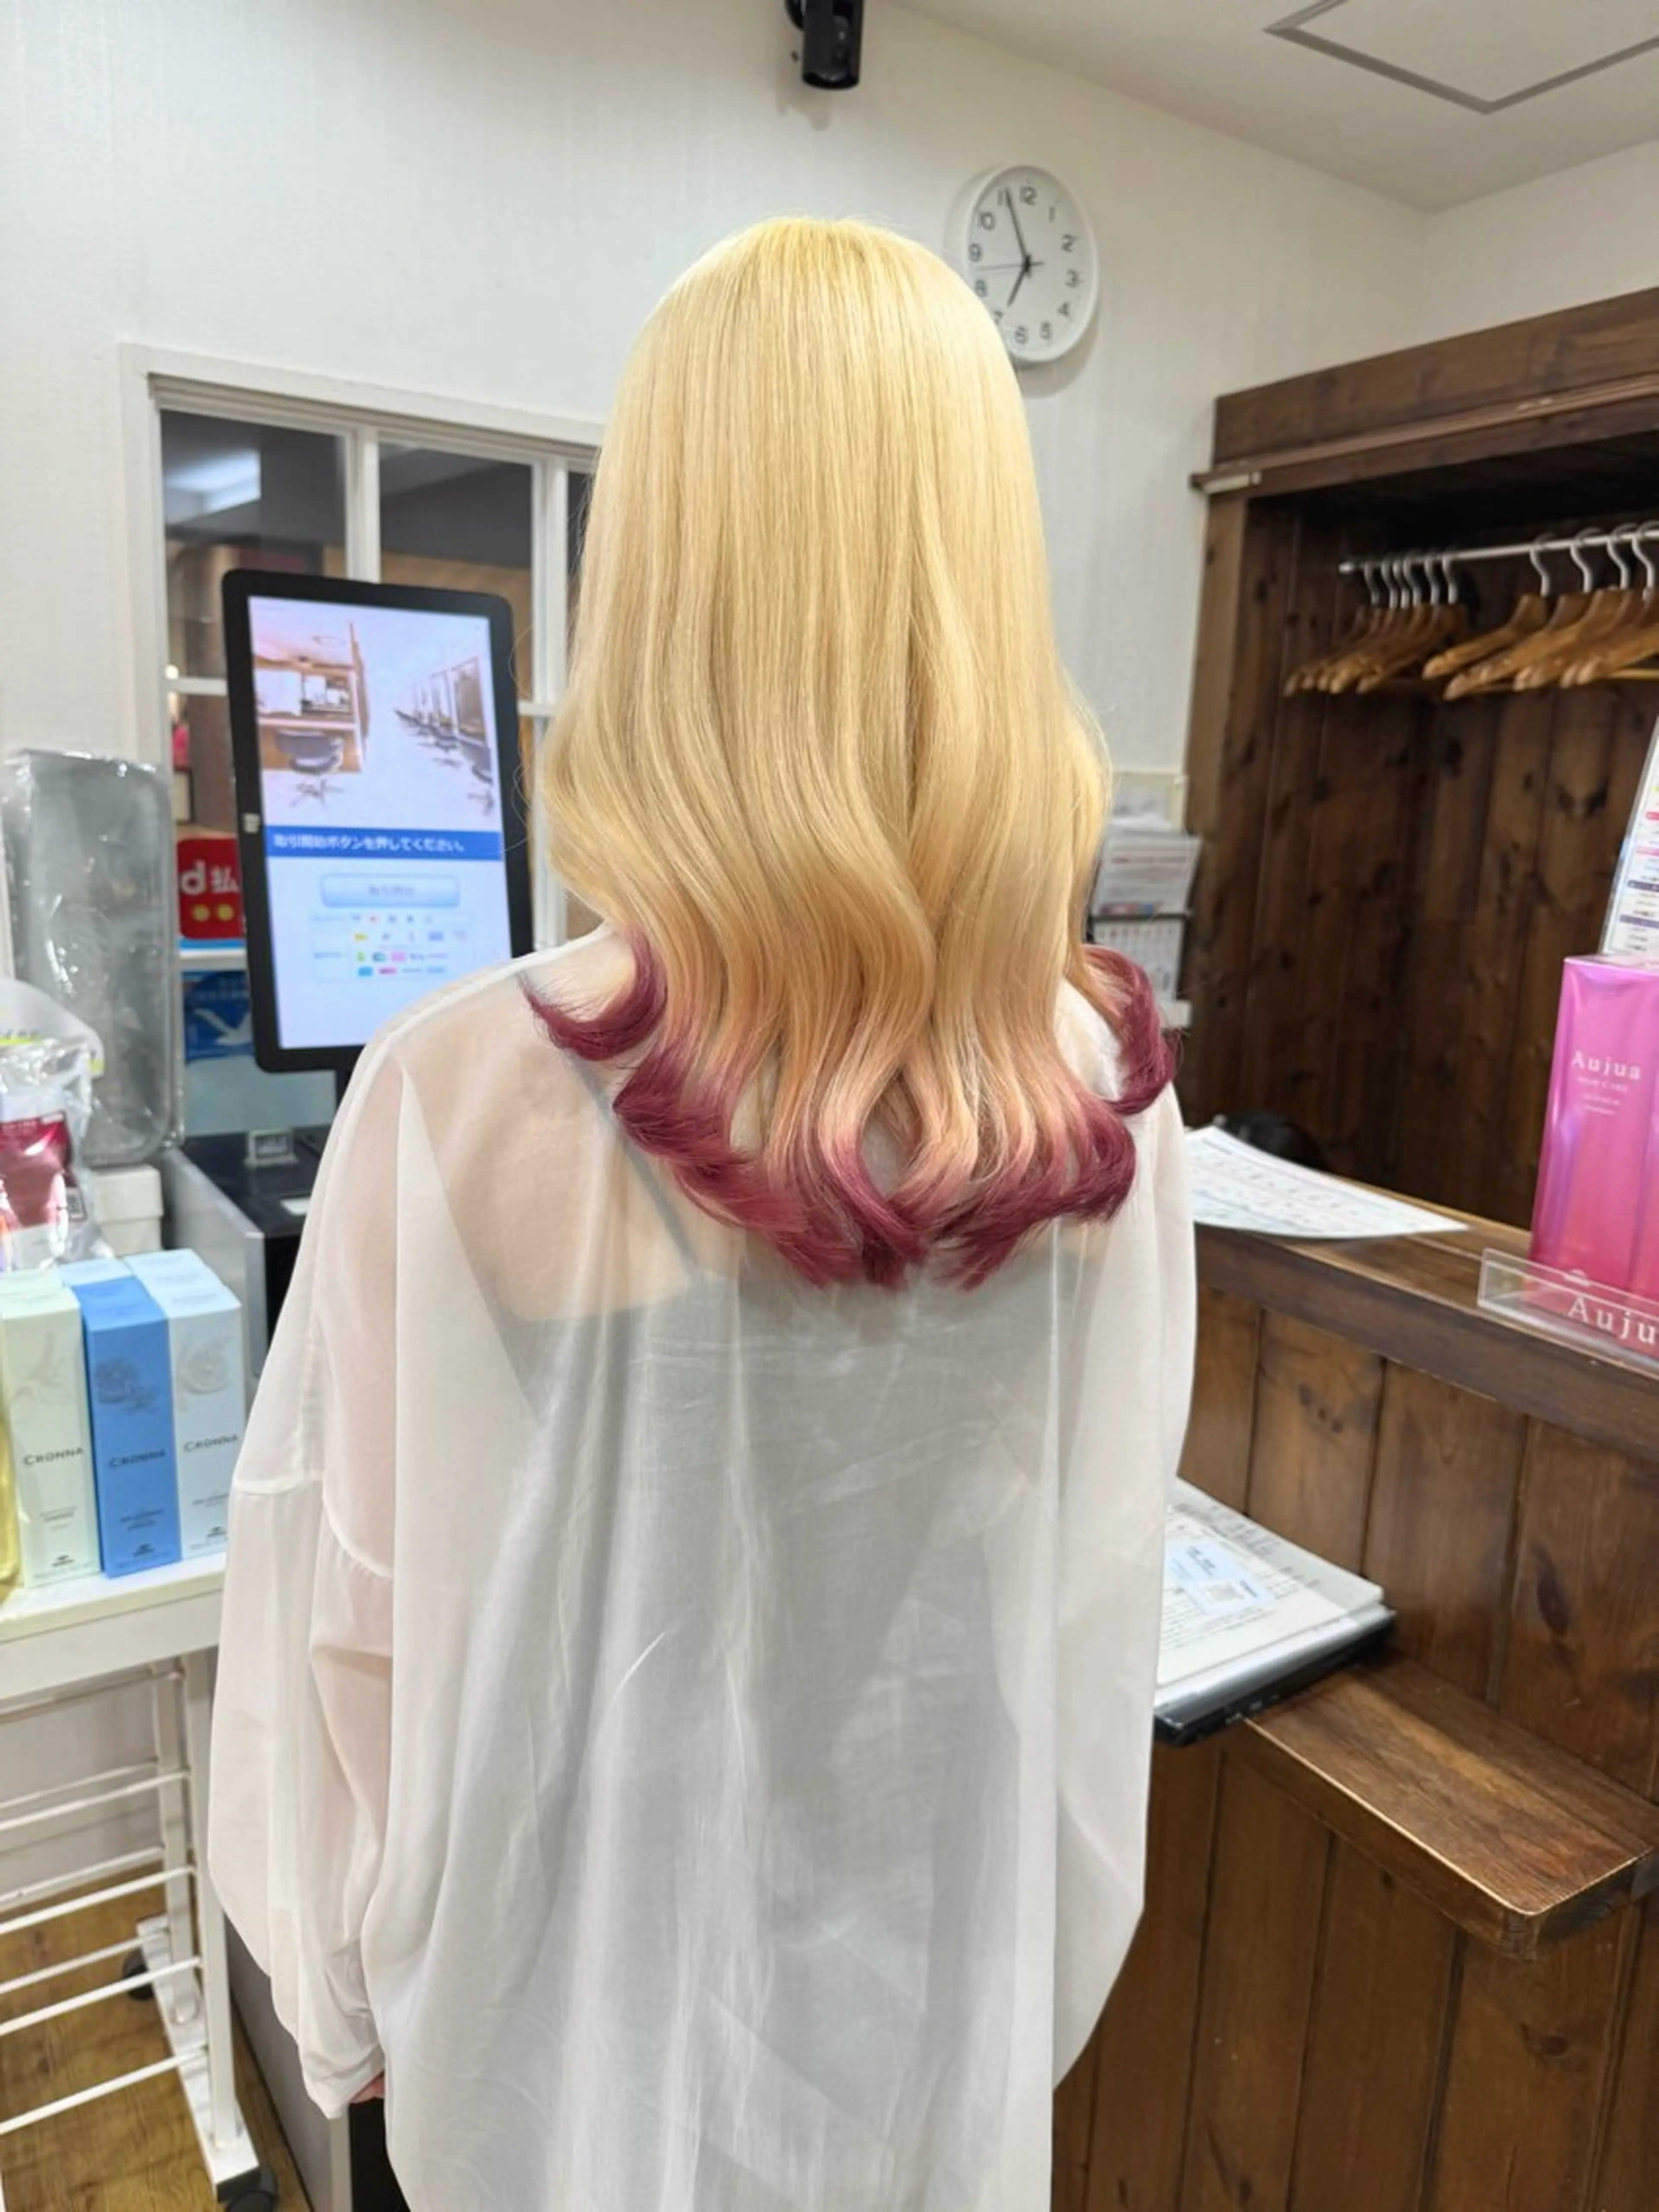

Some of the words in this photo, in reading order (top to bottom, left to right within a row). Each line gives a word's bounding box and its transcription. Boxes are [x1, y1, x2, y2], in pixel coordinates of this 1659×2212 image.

[1020, 186, 1036, 205] 12
[969, 243, 982, 262] 9
[976, 280, 988, 298] 8
[1065, 270, 1079, 289] 3
[1057, 302, 1070, 317] 4
[1014, 326, 1028, 345] 6
[1040, 321, 1051, 340] 5
[1572, 1051, 1640, 1080] Aujua
[184, 1434, 239, 1452] CRONNA
[23, 1446, 84, 1466] CRONNA
[109, 1449, 167, 1468] CRONNA
